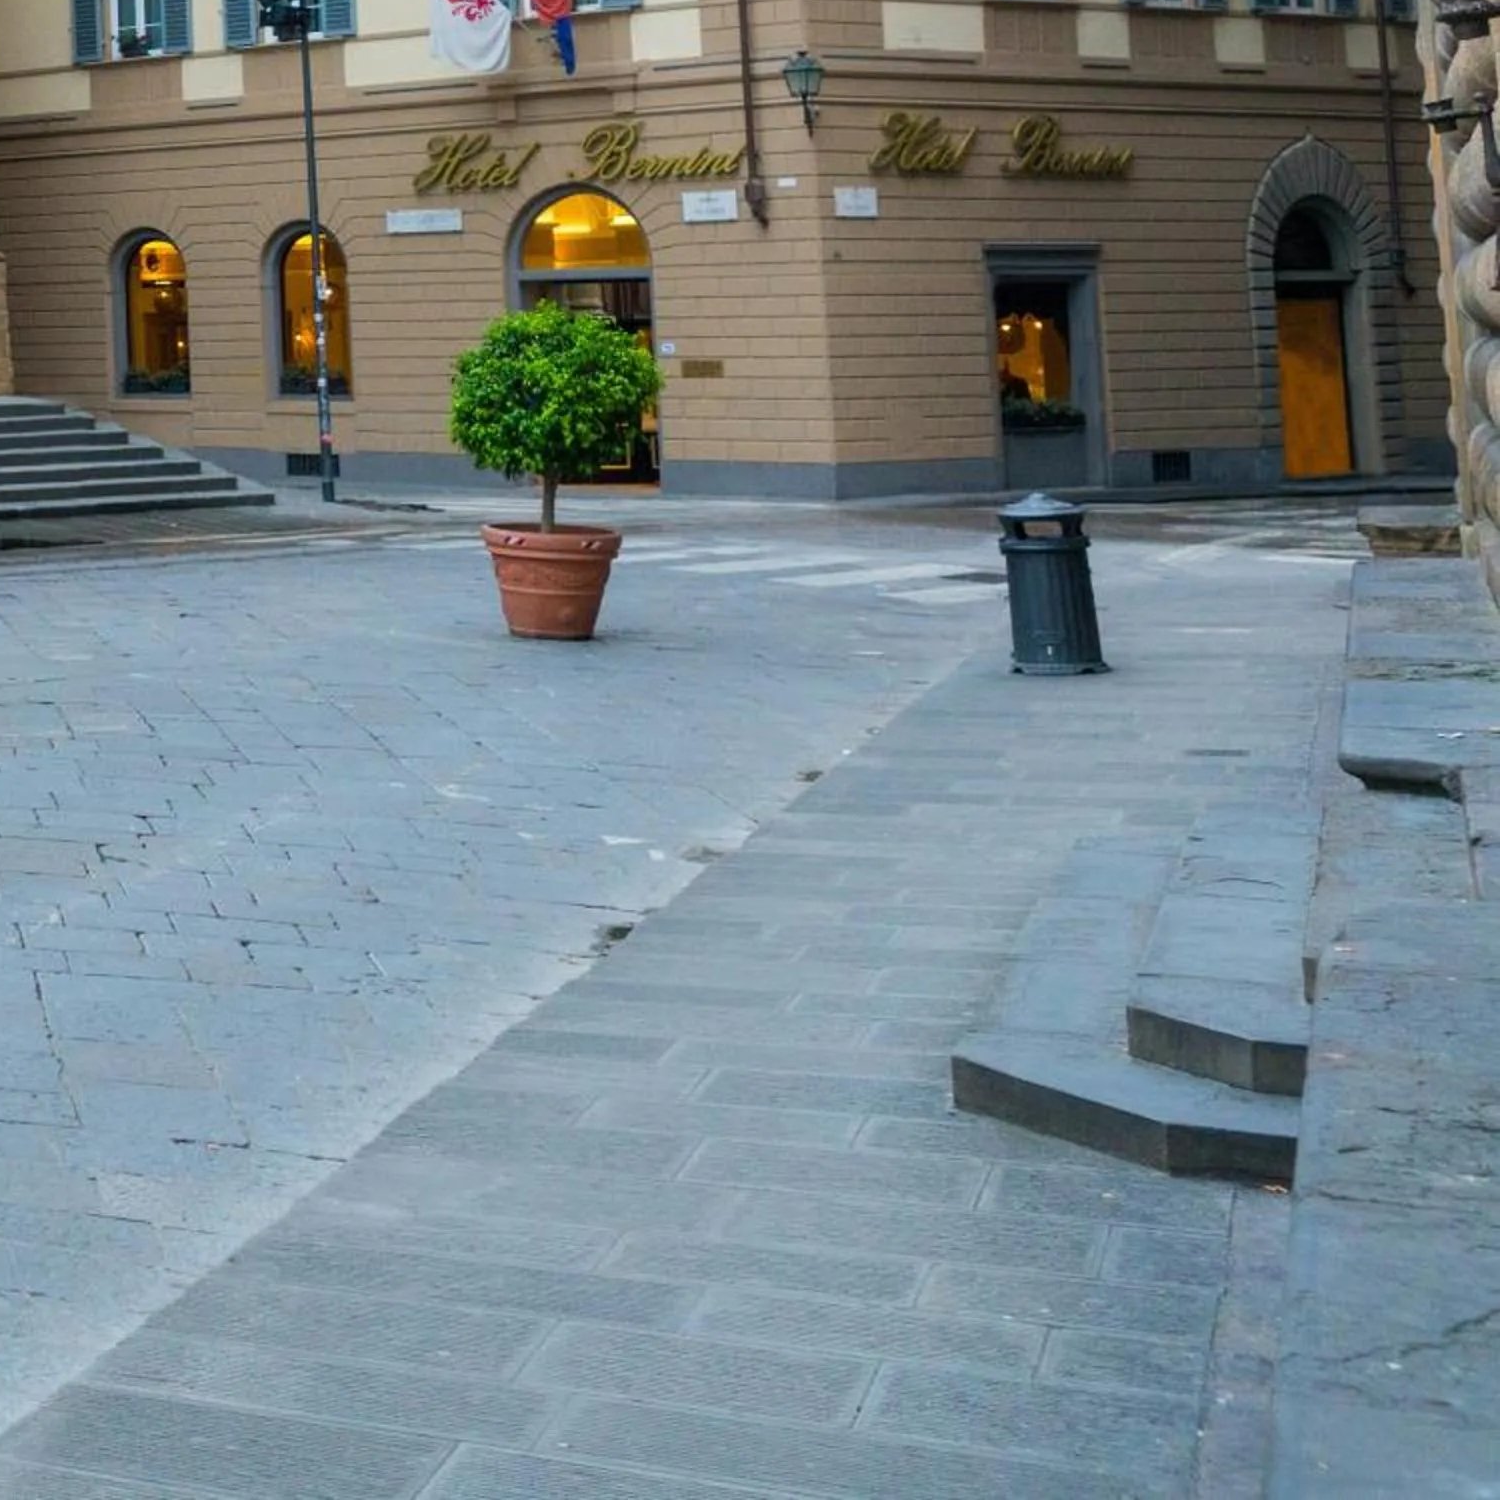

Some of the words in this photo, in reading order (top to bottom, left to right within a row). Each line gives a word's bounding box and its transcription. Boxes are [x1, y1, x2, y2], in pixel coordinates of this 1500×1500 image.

[413, 133, 541, 191] Hotel
[567, 118, 746, 183] Bernini
[867, 112, 979, 173] Hotel
